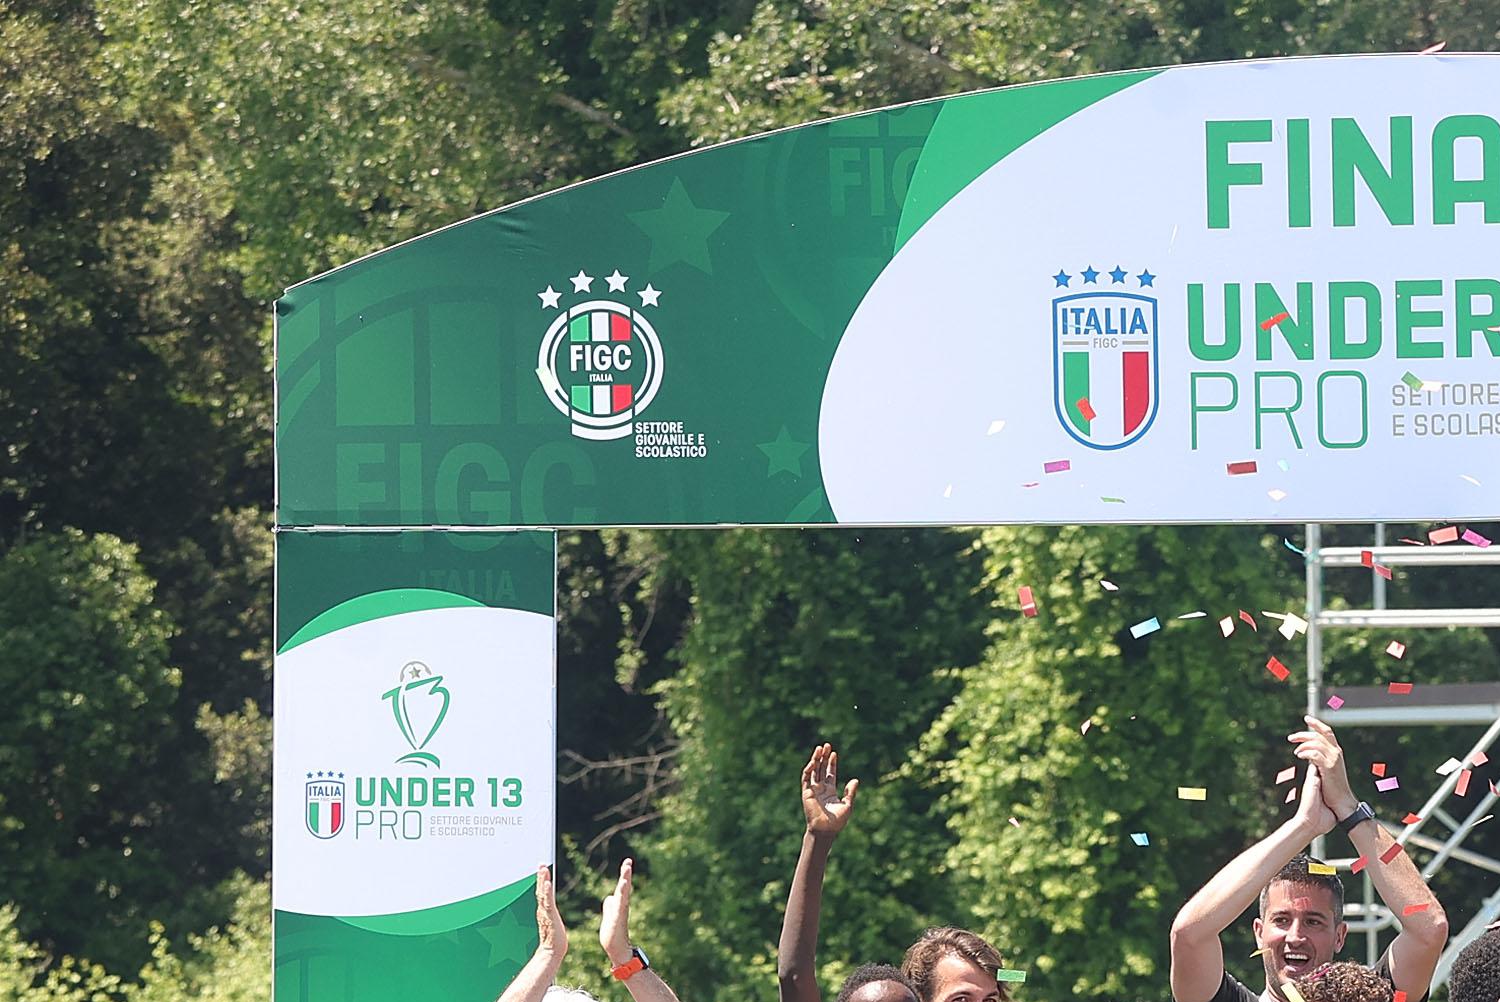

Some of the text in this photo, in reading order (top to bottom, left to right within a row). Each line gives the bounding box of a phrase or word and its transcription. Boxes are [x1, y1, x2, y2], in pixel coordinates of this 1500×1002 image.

[1061, 307, 1148, 335] ITALIA
[1093, 337, 1119, 349] FIGC
[570, 344, 632, 372] FIGC
[589, 374, 613, 382] ITALIA
[1391, 382, 1500, 406] SETTORE
[1191, 370, 1368, 450] PRO
[635, 421, 684, 434] SETTORE
[1392, 414, 1405, 436] E
[635, 433, 705, 447] GIOVANILE E
[635, 445, 707, 458] SCOLASTICO
[337, 443, 598, 540] FIGC
[308, 786, 341, 797] ITALIA
[355, 777, 523, 808] UNDER 13
[355, 810, 422, 840] PRO
[430, 816, 523, 826] SETTORE GIOVANILE
[430, 827, 495, 837] E SCOLASTICO
